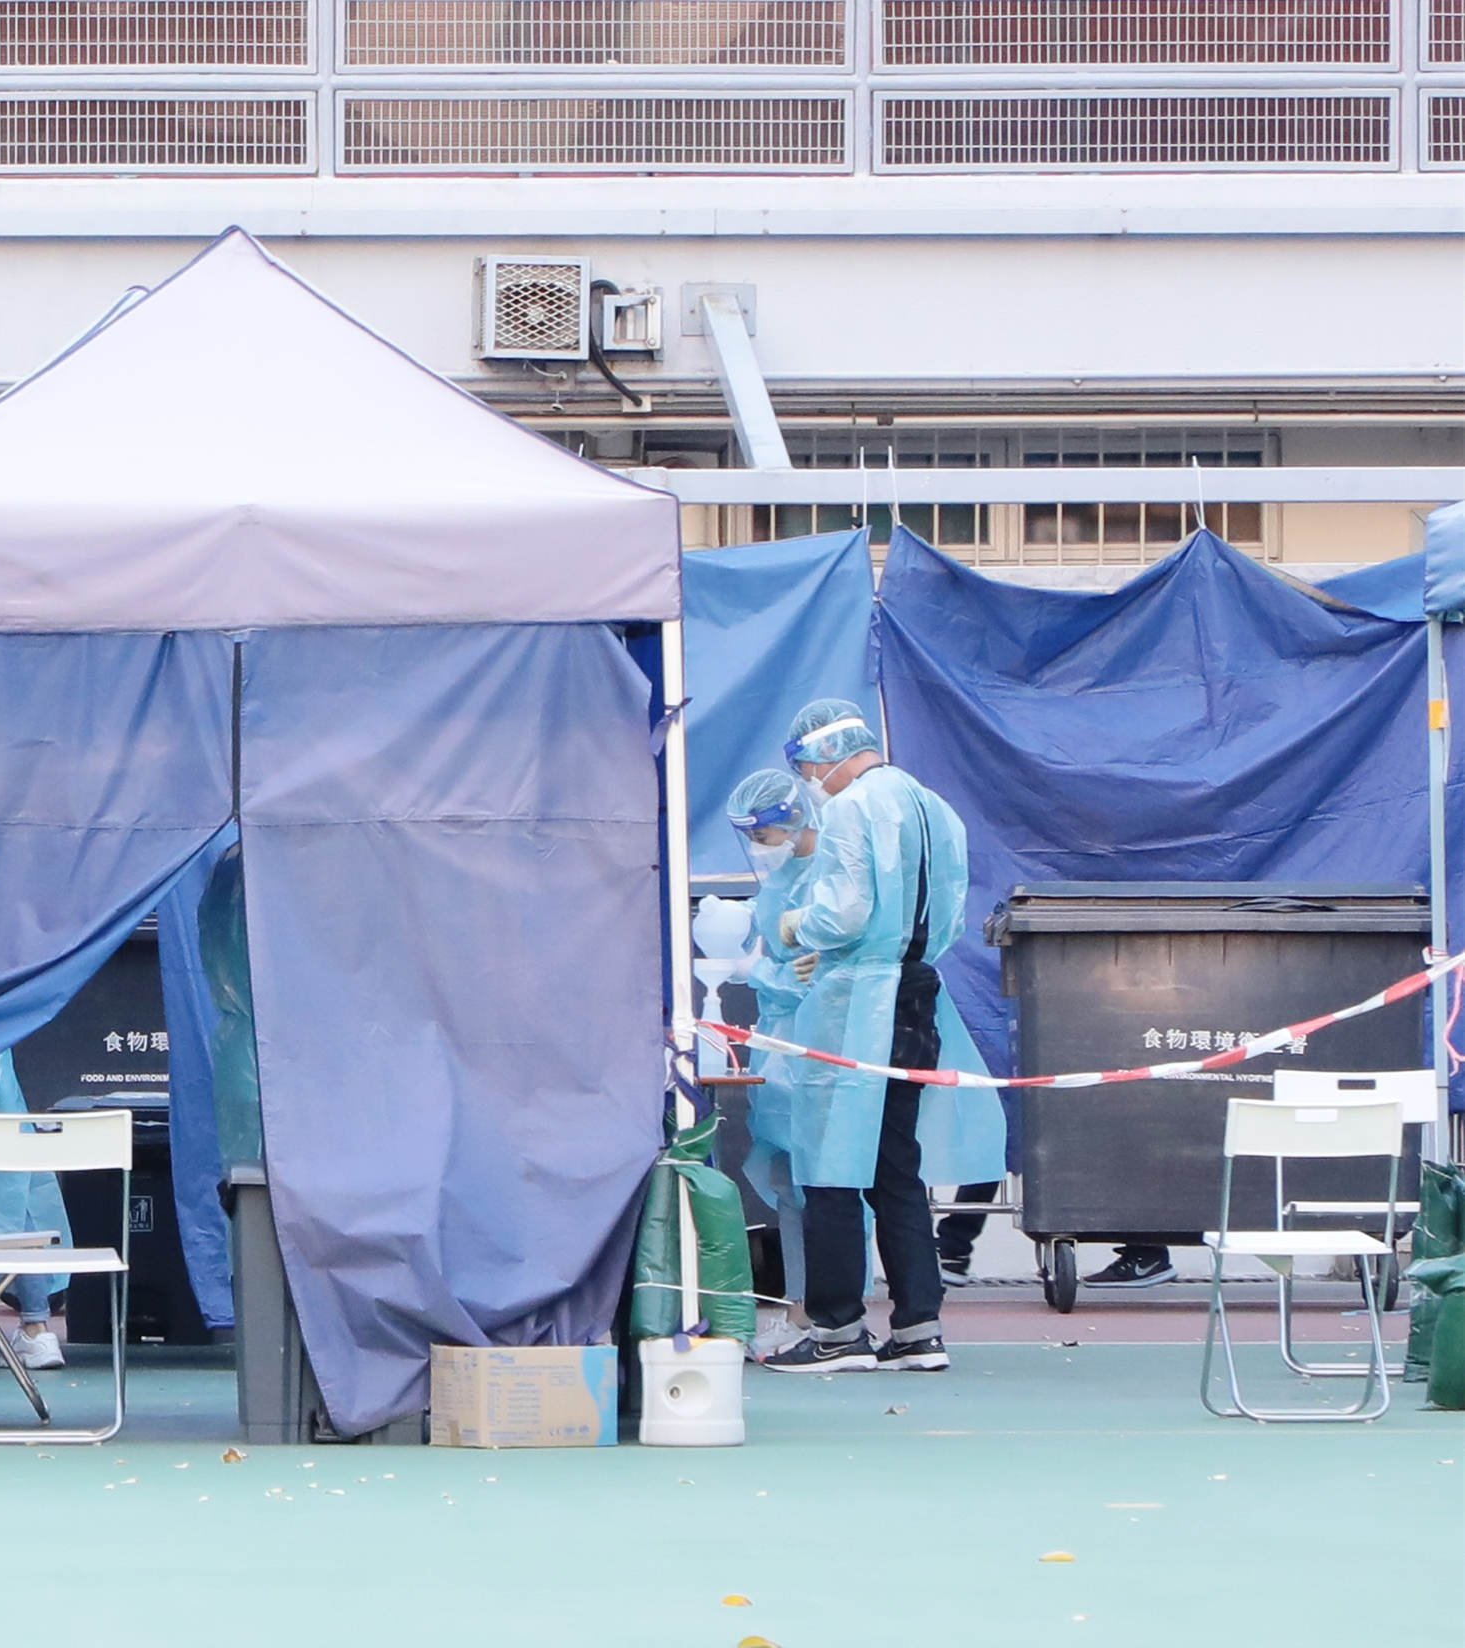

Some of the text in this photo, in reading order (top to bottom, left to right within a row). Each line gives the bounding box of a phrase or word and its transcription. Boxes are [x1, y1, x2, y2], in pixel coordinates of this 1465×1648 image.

[1142, 1027, 1308, 1055] 食物環境衛署
[80, 1074, 105, 1082] FOOD
[106, 1074, 124, 1082] AND
